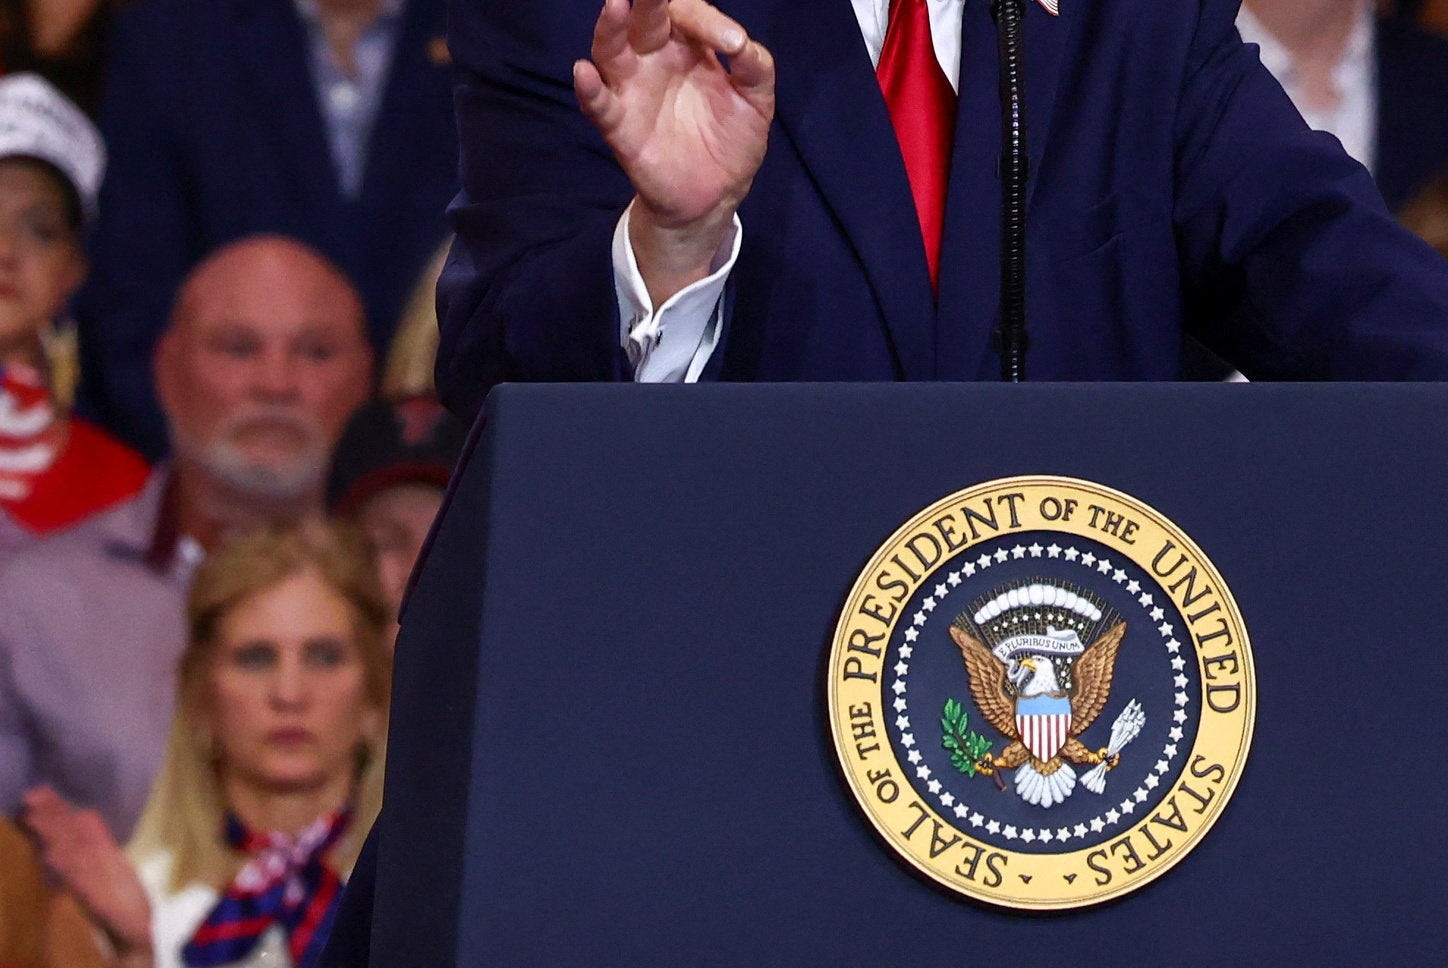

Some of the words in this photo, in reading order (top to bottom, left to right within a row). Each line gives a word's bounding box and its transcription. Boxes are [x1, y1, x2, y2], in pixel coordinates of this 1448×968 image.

[1039, 496, 1078, 522] OF
[1088, 504, 1140, 545] THE
[843, 492, 1025, 684] PRESIDENT
[998, 647, 1007, 657] E
[1005, 638, 1051, 652] PLURIBUS
[1052, 641, 1080, 651] UNUM
[1151, 539, 1241, 713] UNITED
[849, 701, 881, 760] THE
[866, 768, 900, 804] OF
[901, 801, 1008, 888] SEAL
[1086, 754, 1225, 887] STATES
